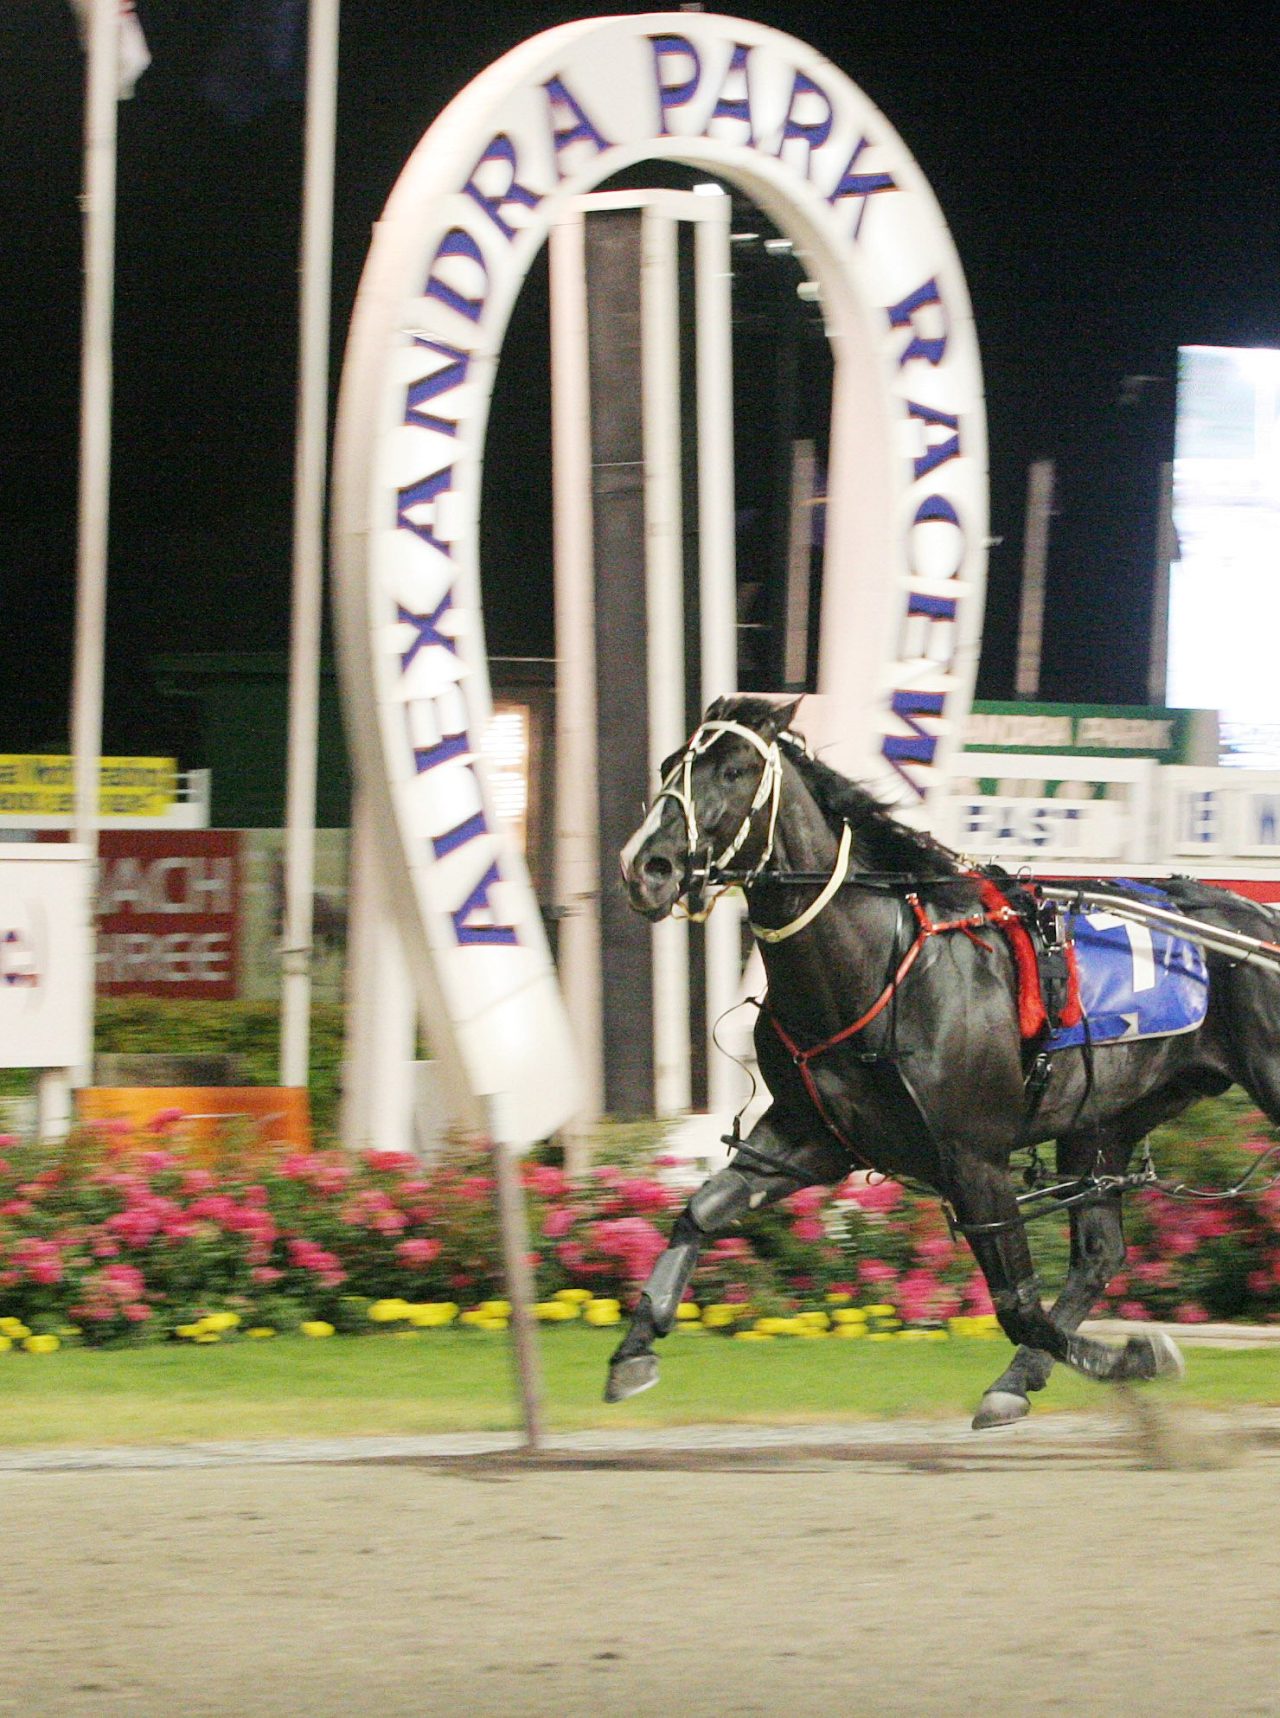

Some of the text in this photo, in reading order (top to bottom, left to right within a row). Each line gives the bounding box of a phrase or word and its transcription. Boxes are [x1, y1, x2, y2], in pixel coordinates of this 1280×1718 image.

[396, 33, 963, 946] ALEXANDRA PARK RACEW
